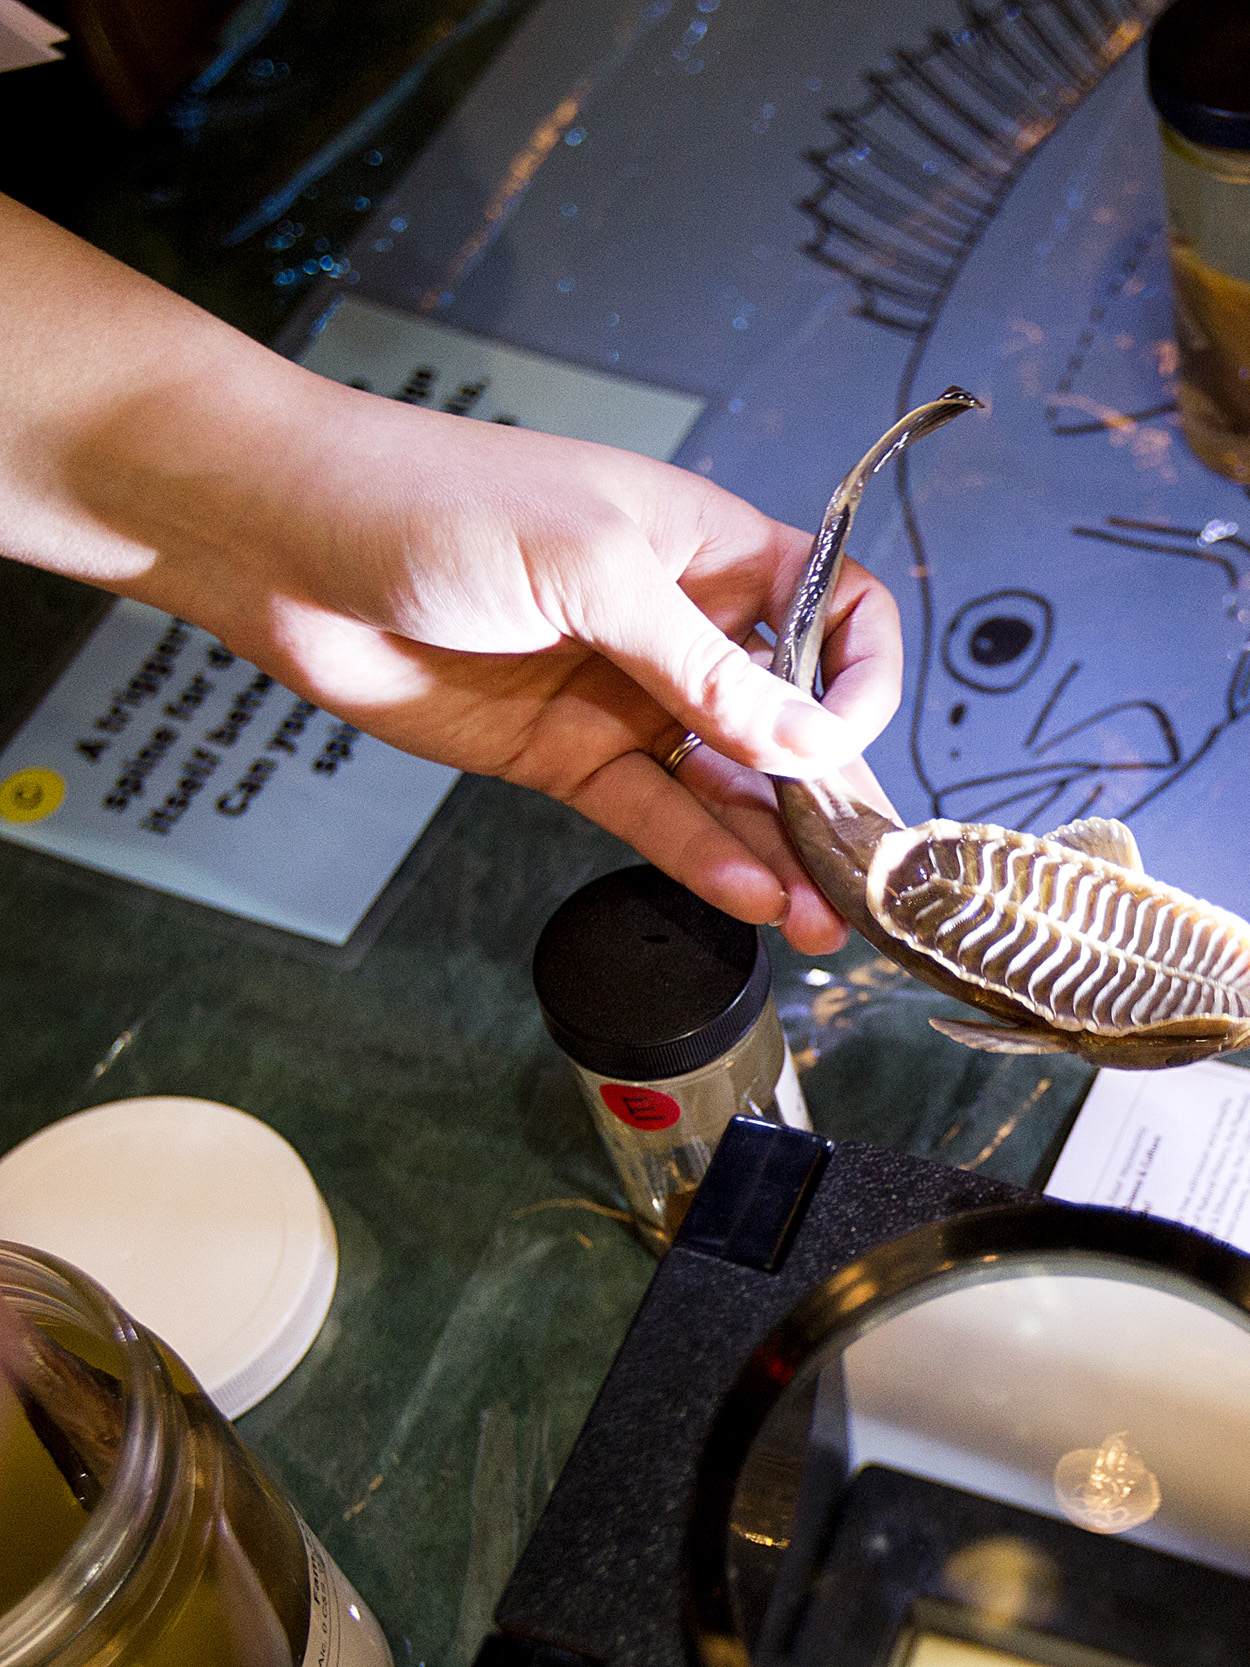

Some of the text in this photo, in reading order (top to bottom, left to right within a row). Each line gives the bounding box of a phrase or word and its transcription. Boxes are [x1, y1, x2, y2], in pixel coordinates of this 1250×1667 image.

[75, 738, 109, 764] A
[101, 723, 178, 814] spine
[161, 670, 214, 722] for
[137, 671, 276, 835] itself betw
[214, 758, 279, 819] Can
[622, 1096, 666, 1121] E
